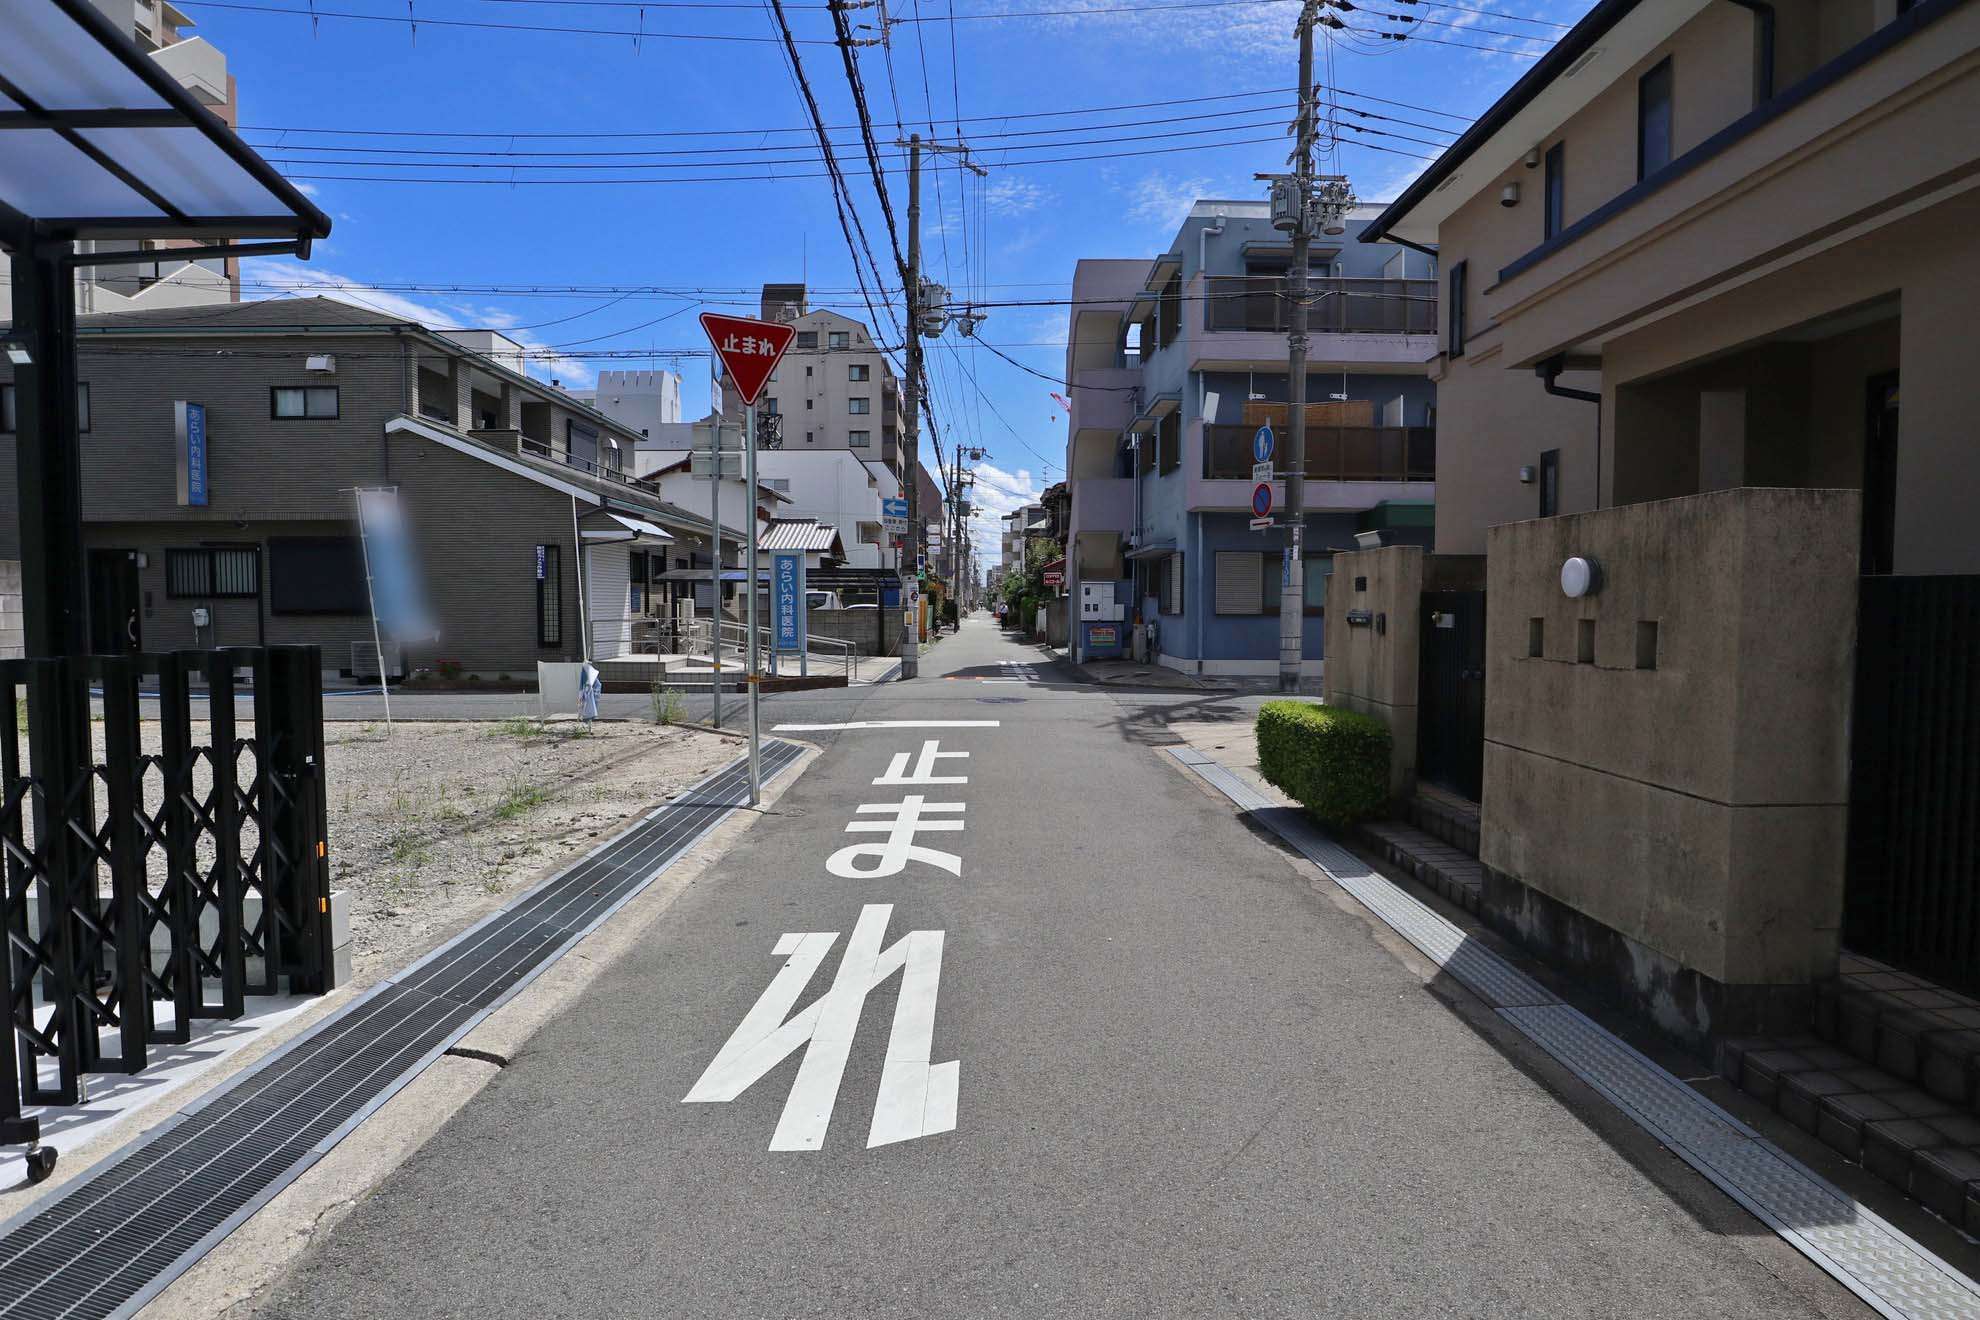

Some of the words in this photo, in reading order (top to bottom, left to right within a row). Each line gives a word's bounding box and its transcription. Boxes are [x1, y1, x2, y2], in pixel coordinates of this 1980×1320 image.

[721, 333, 776, 357] 止まれ
[780, 559, 794, 638] あらい内科医院
[680, 740, 969, 1151] 止まれ
